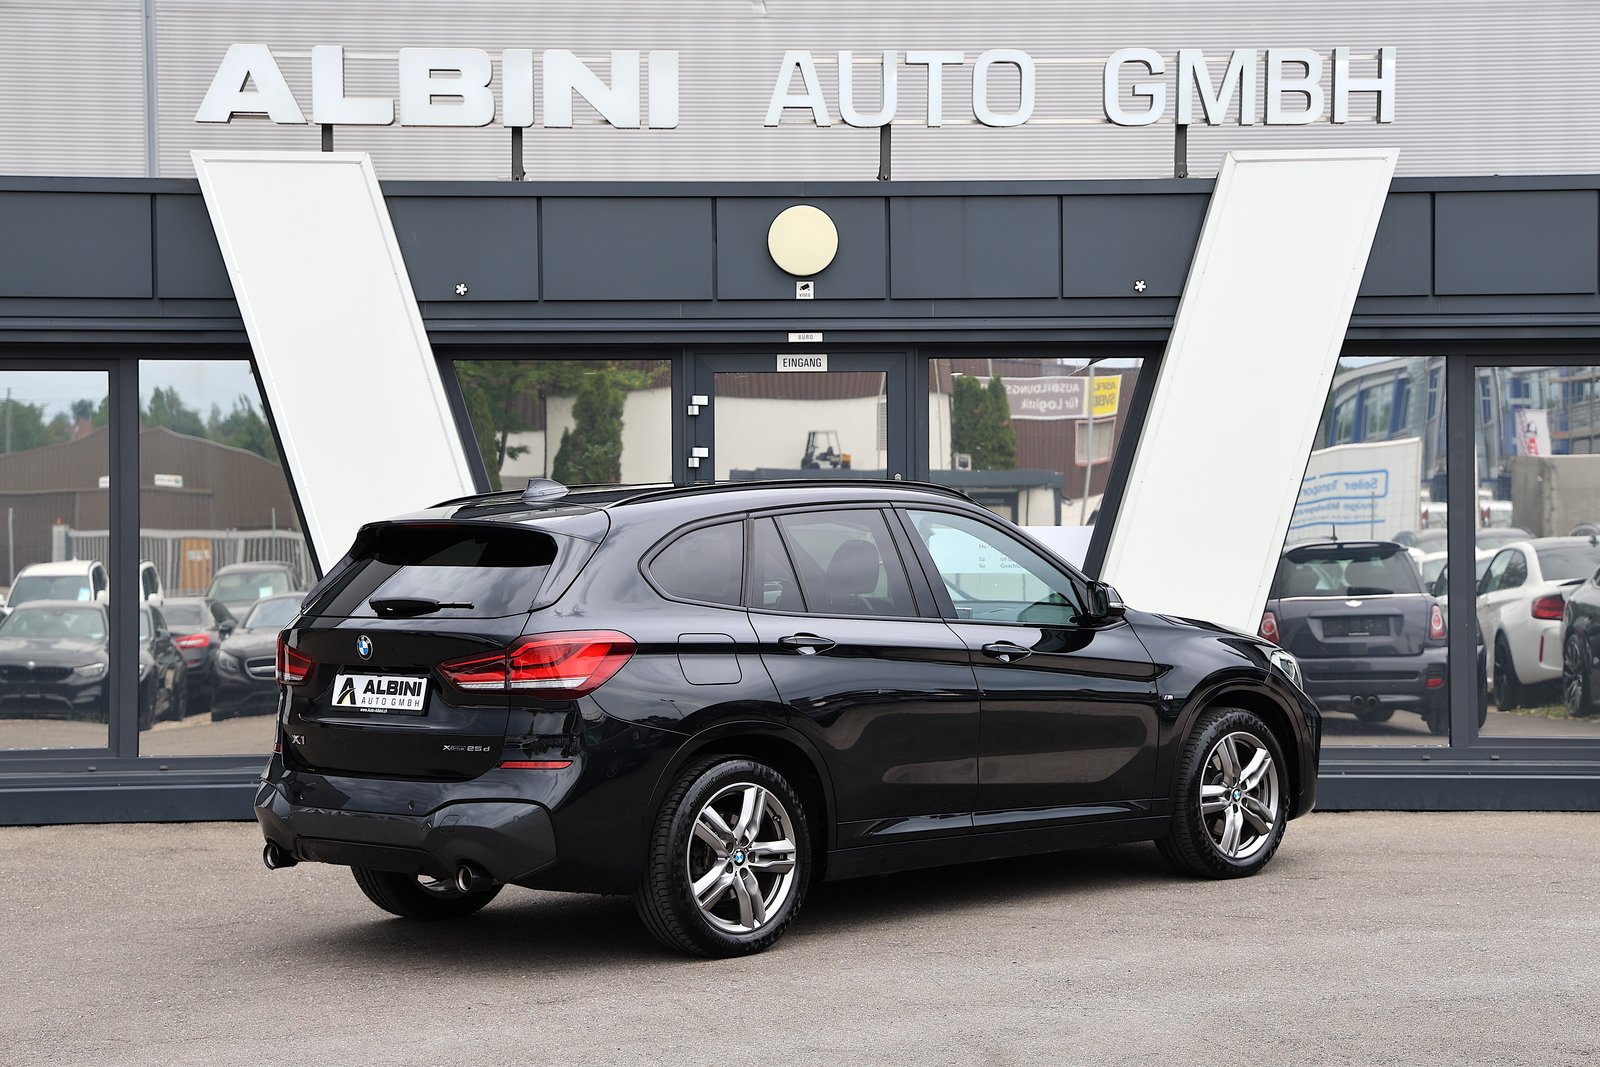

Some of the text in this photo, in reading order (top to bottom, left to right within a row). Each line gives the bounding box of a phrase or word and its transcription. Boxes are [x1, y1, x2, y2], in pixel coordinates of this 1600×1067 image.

[194, 43, 1398, 129] ALBINI AUTO GMBH
[782, 358, 822, 368] EINGANG
[363, 680, 422, 696] ALBINI
[360, 696, 420, 707] AUTO GMBH
[291, 734, 305, 745] X1
